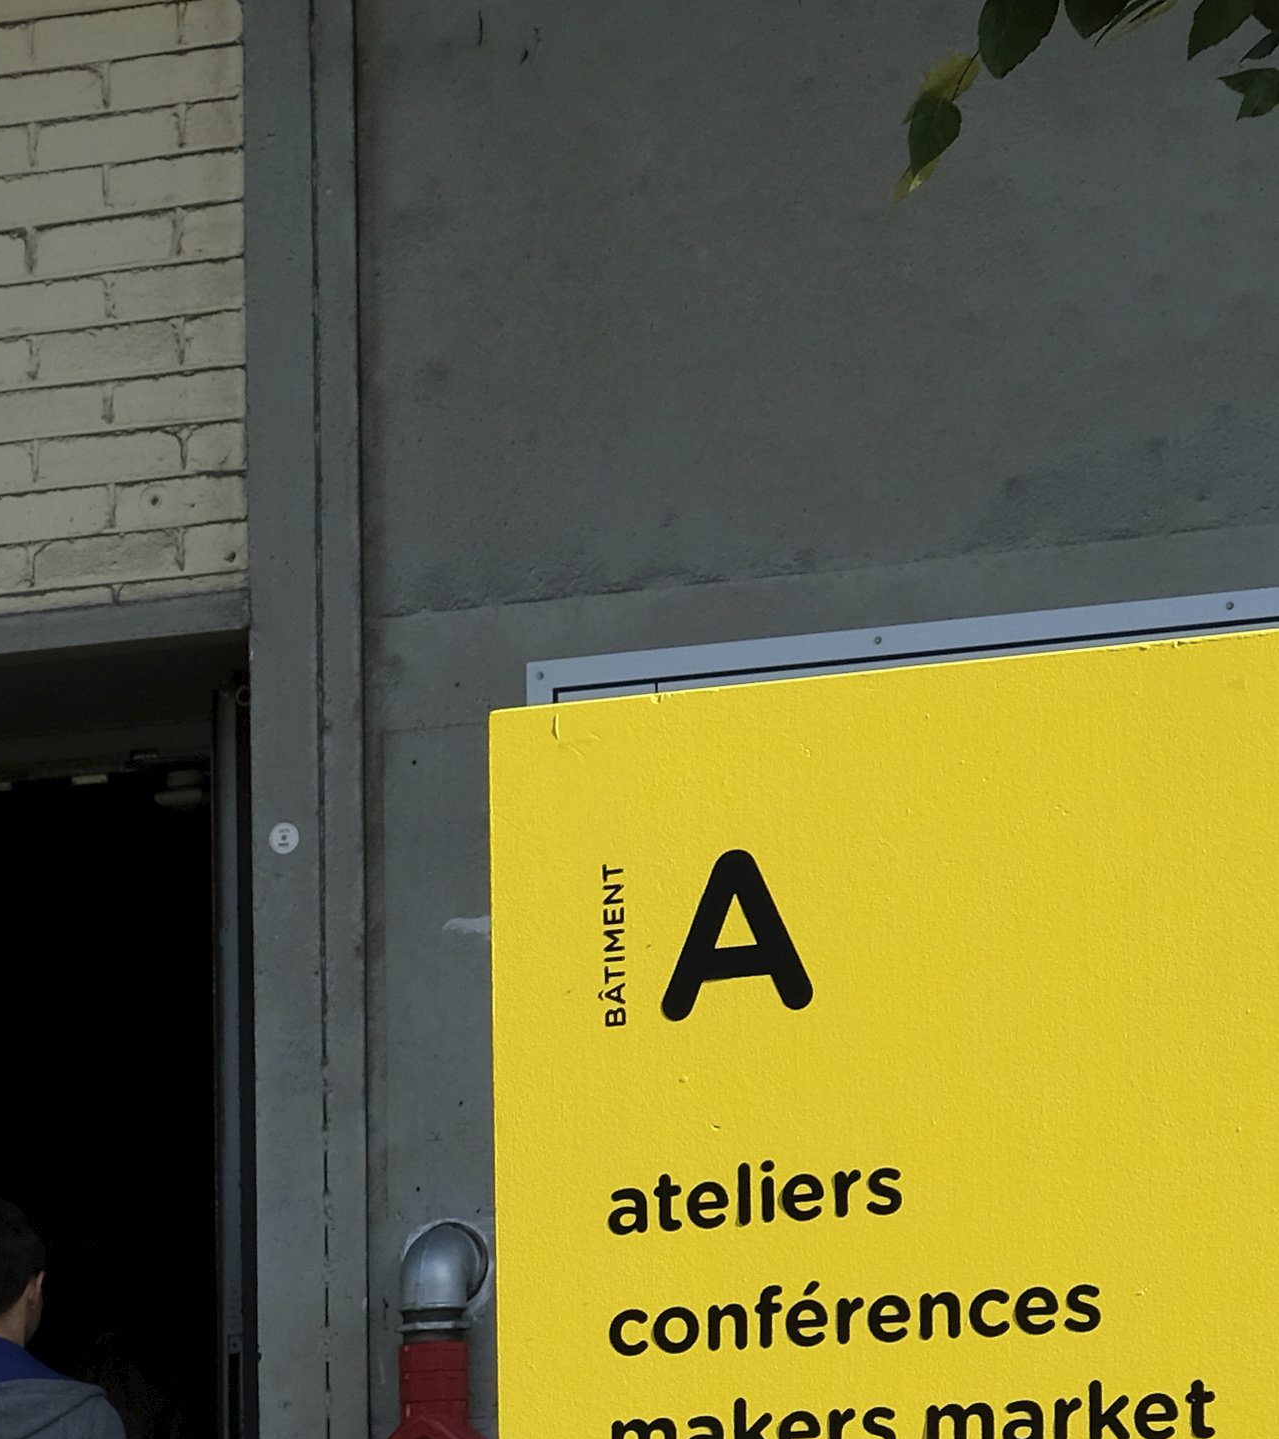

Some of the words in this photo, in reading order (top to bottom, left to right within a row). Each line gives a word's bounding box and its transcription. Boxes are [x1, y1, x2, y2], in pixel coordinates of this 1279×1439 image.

[599, 864, 627, 1028] BÂTIMENT
[661, 848, 814, 1022] A
[607, 1160, 903, 1236] ateliers
[608, 1280, 1102, 1357] conférences
